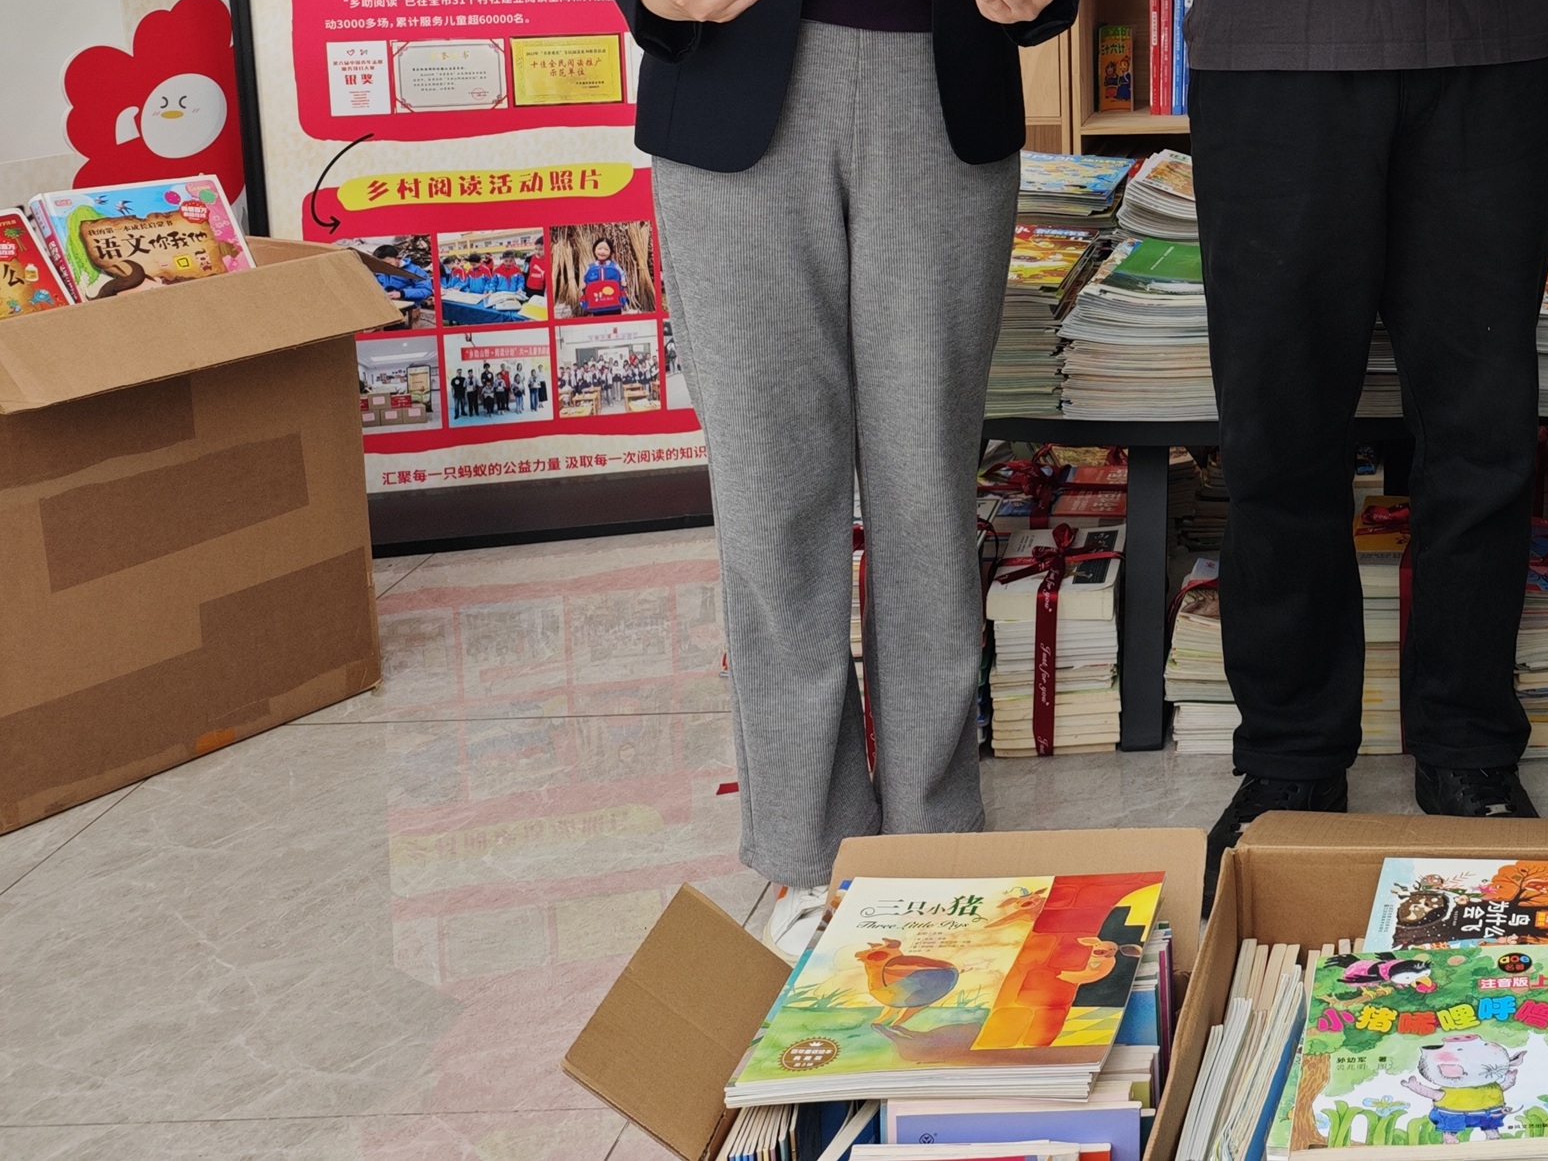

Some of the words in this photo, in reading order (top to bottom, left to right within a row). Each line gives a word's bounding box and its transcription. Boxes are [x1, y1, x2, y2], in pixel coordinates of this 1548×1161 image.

[366, 169, 603, 202] 乡村阅读活动照片
[382, 457, 562, 486] 汇聚每一只蚂蚁的公益力量
[565, 445, 708, 470] 汲取每一次阅读的知识
[862, 895, 987, 921] 三只小猪
[857, 920, 897, 929] Three
[897, 920, 935, 930] Little
[937, 920, 970, 930] Pigs
[1498, 955, 1530, 964] aoe
[1479, 977, 1529, 989] 注音版
